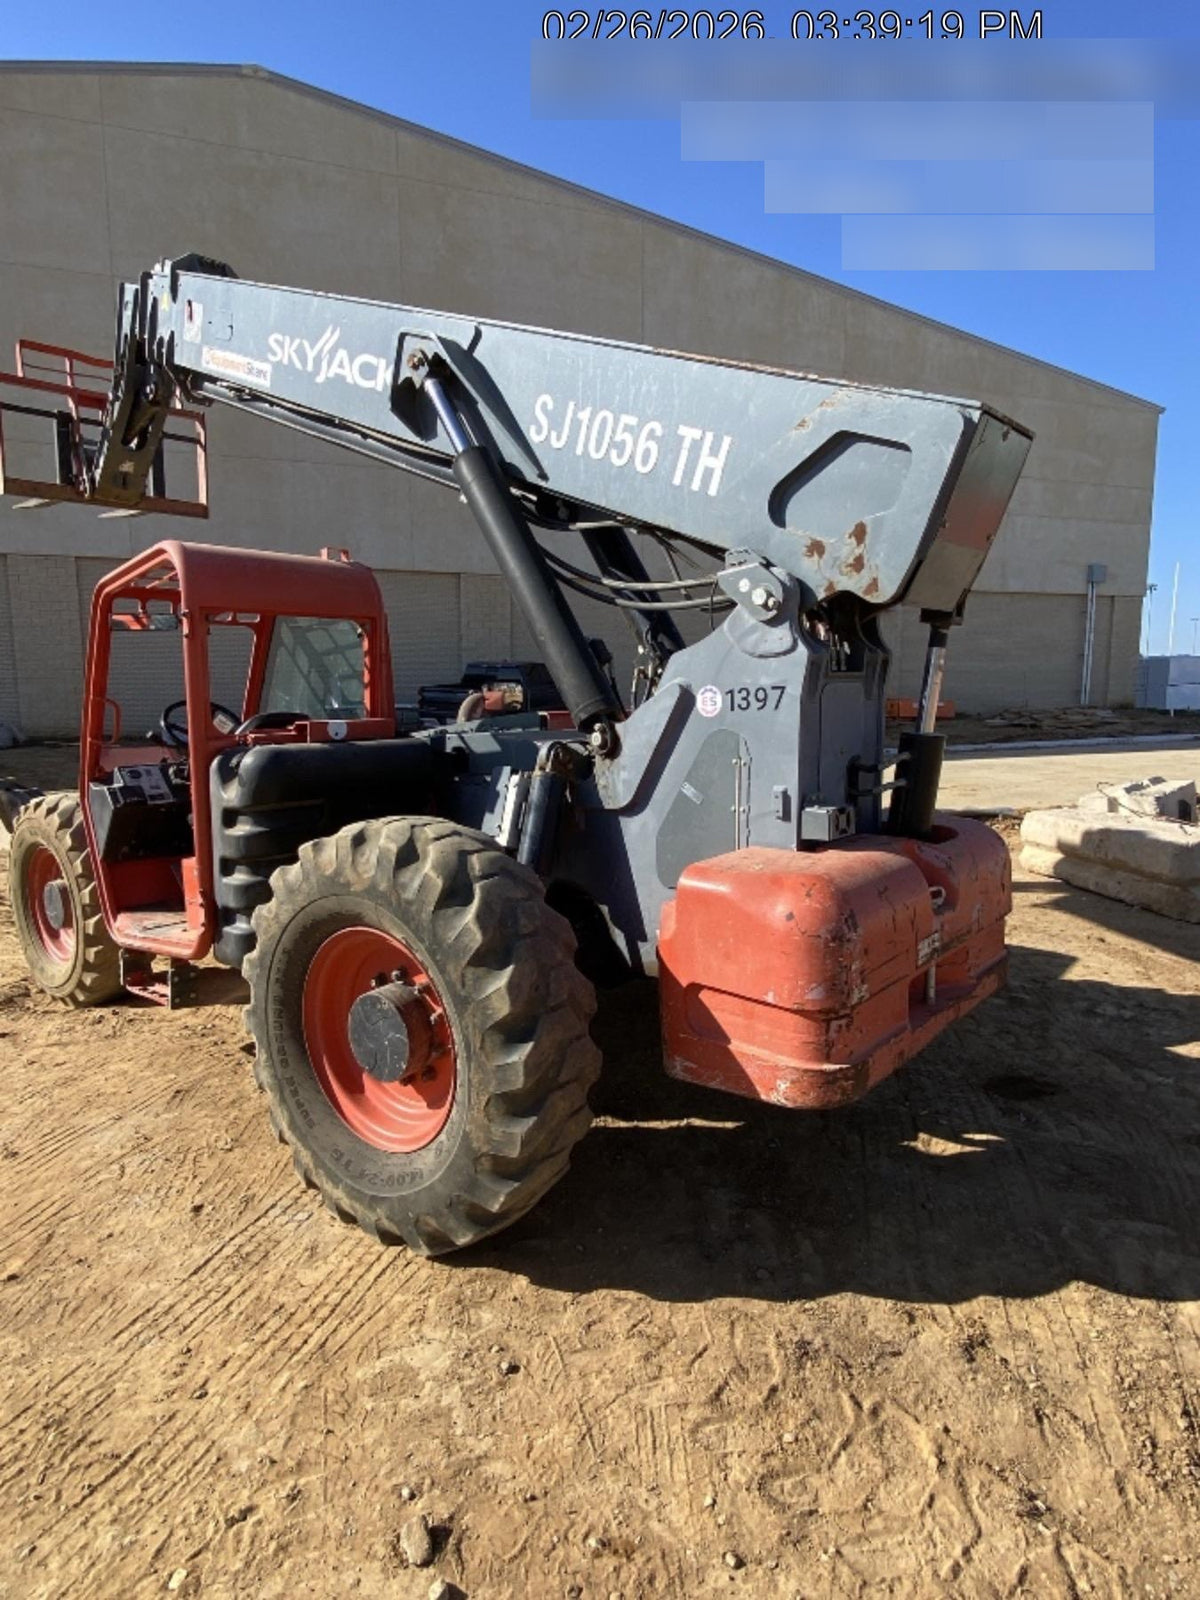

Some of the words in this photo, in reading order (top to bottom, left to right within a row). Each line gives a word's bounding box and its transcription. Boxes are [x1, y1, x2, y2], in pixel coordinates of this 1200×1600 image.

[529, 393, 663, 475] SJ1056
[672, 424, 733, 497] TH
[725, 685, 787, 712] 1397
